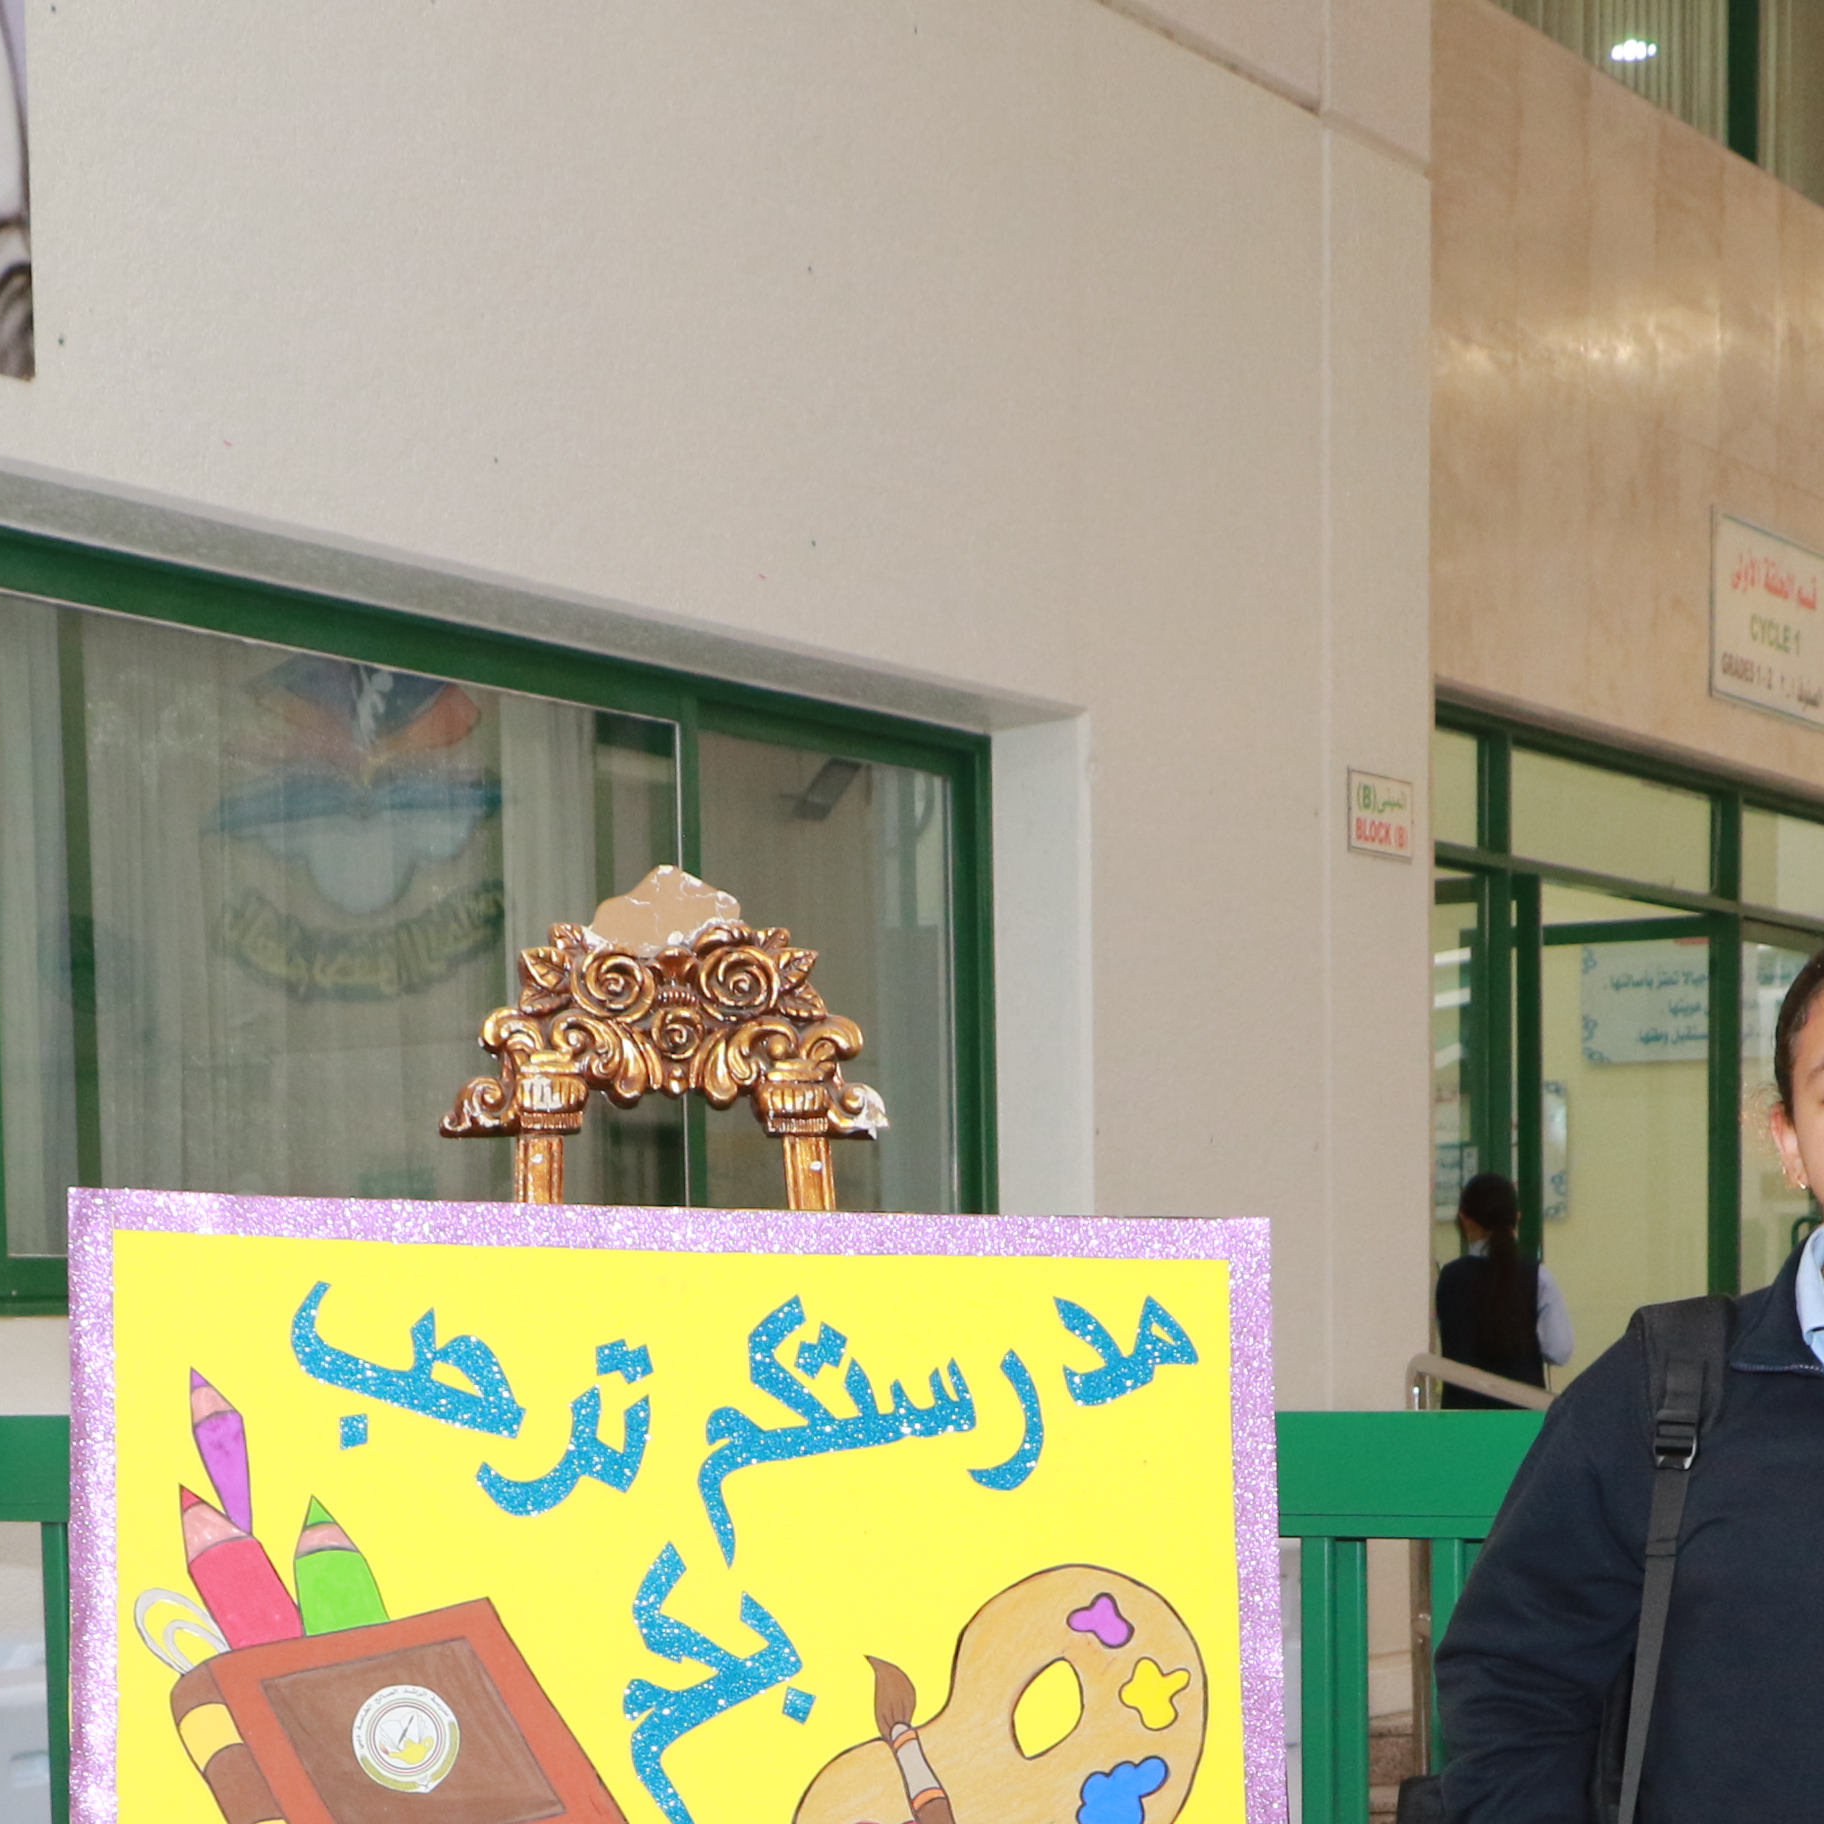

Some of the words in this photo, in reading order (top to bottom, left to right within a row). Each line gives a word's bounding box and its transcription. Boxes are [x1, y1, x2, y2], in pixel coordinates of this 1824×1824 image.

[1750, 613, 1791, 653] CYCLE
[1721, 651, 1755, 684] GRADES
[1355, 817, 1392, 845] BLOCK
[291, 1280, 656, 1517] ترحب
[696, 1294, 1200, 1568] مدرستكم
